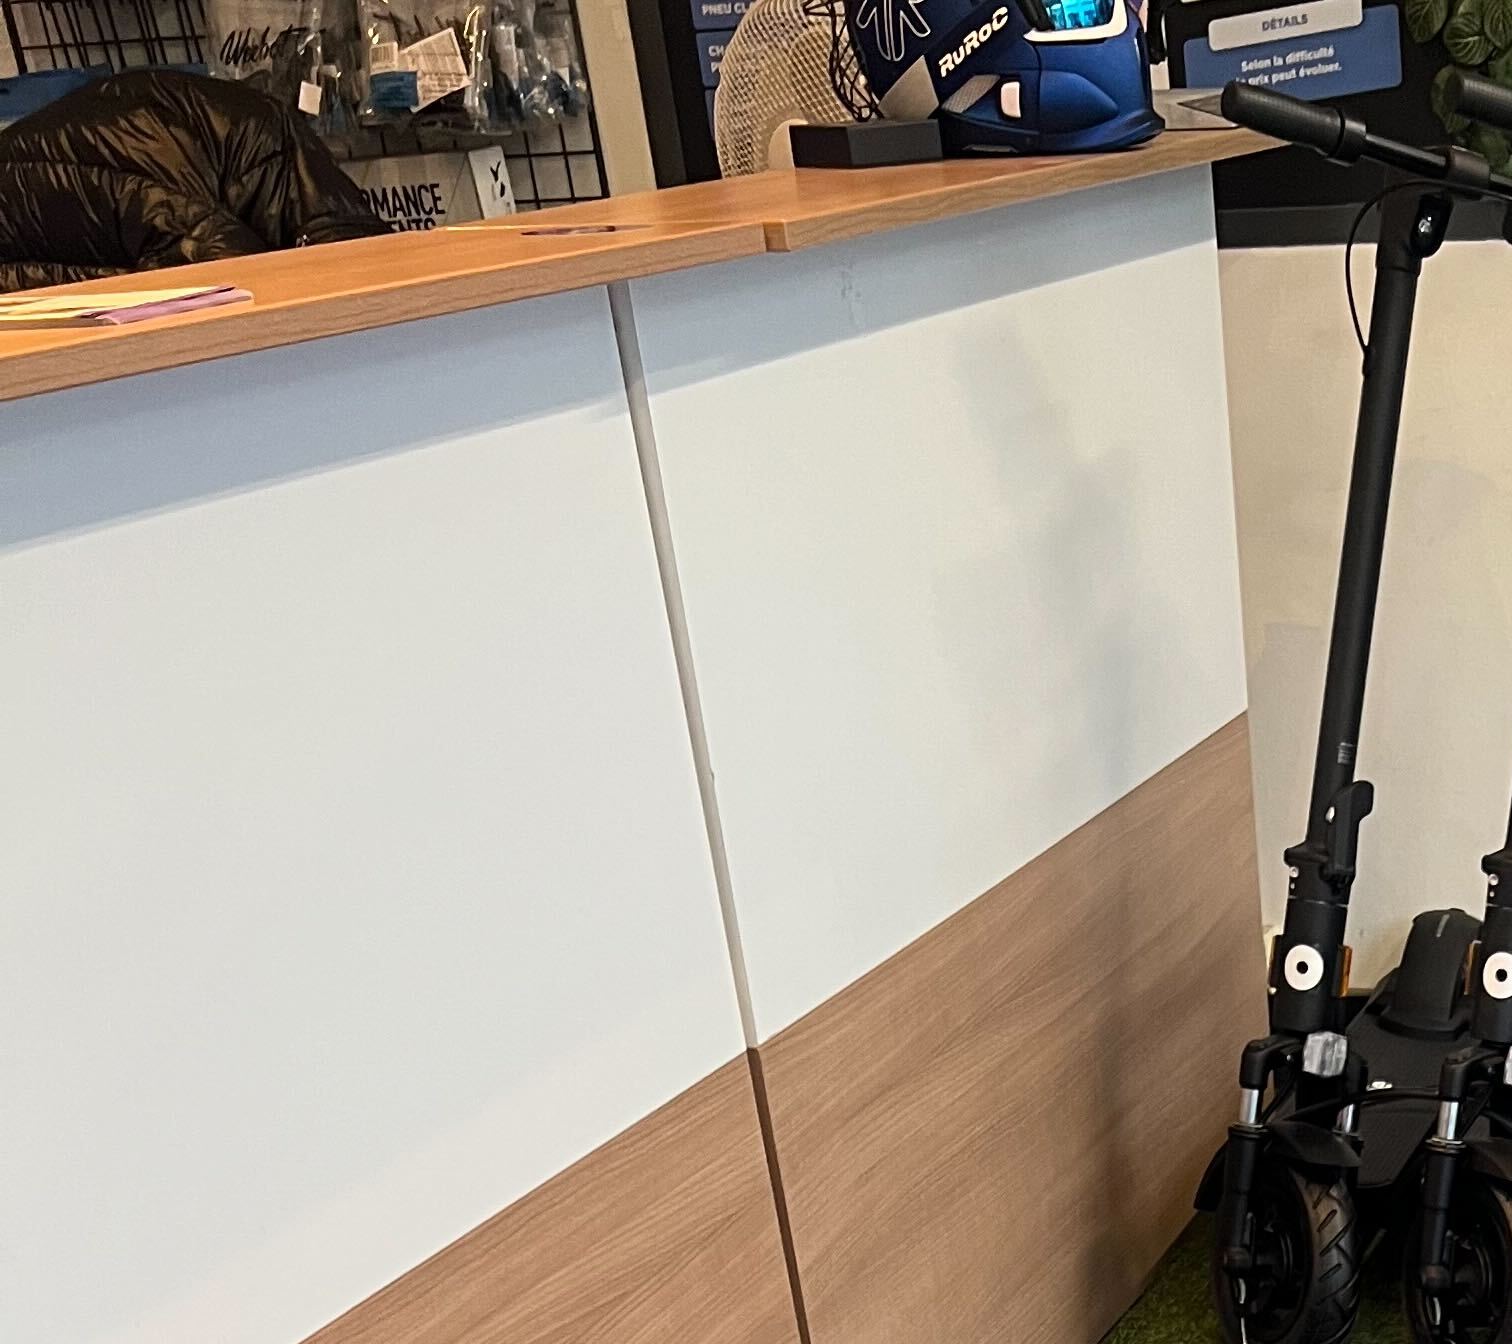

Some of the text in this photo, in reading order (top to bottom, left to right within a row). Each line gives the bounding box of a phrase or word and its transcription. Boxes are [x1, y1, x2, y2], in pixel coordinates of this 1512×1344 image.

[1261, 13, 1309, 32] DÉTAILS
[1241, 56, 1272, 73] Selon
[1273, 55, 1284, 67] la
